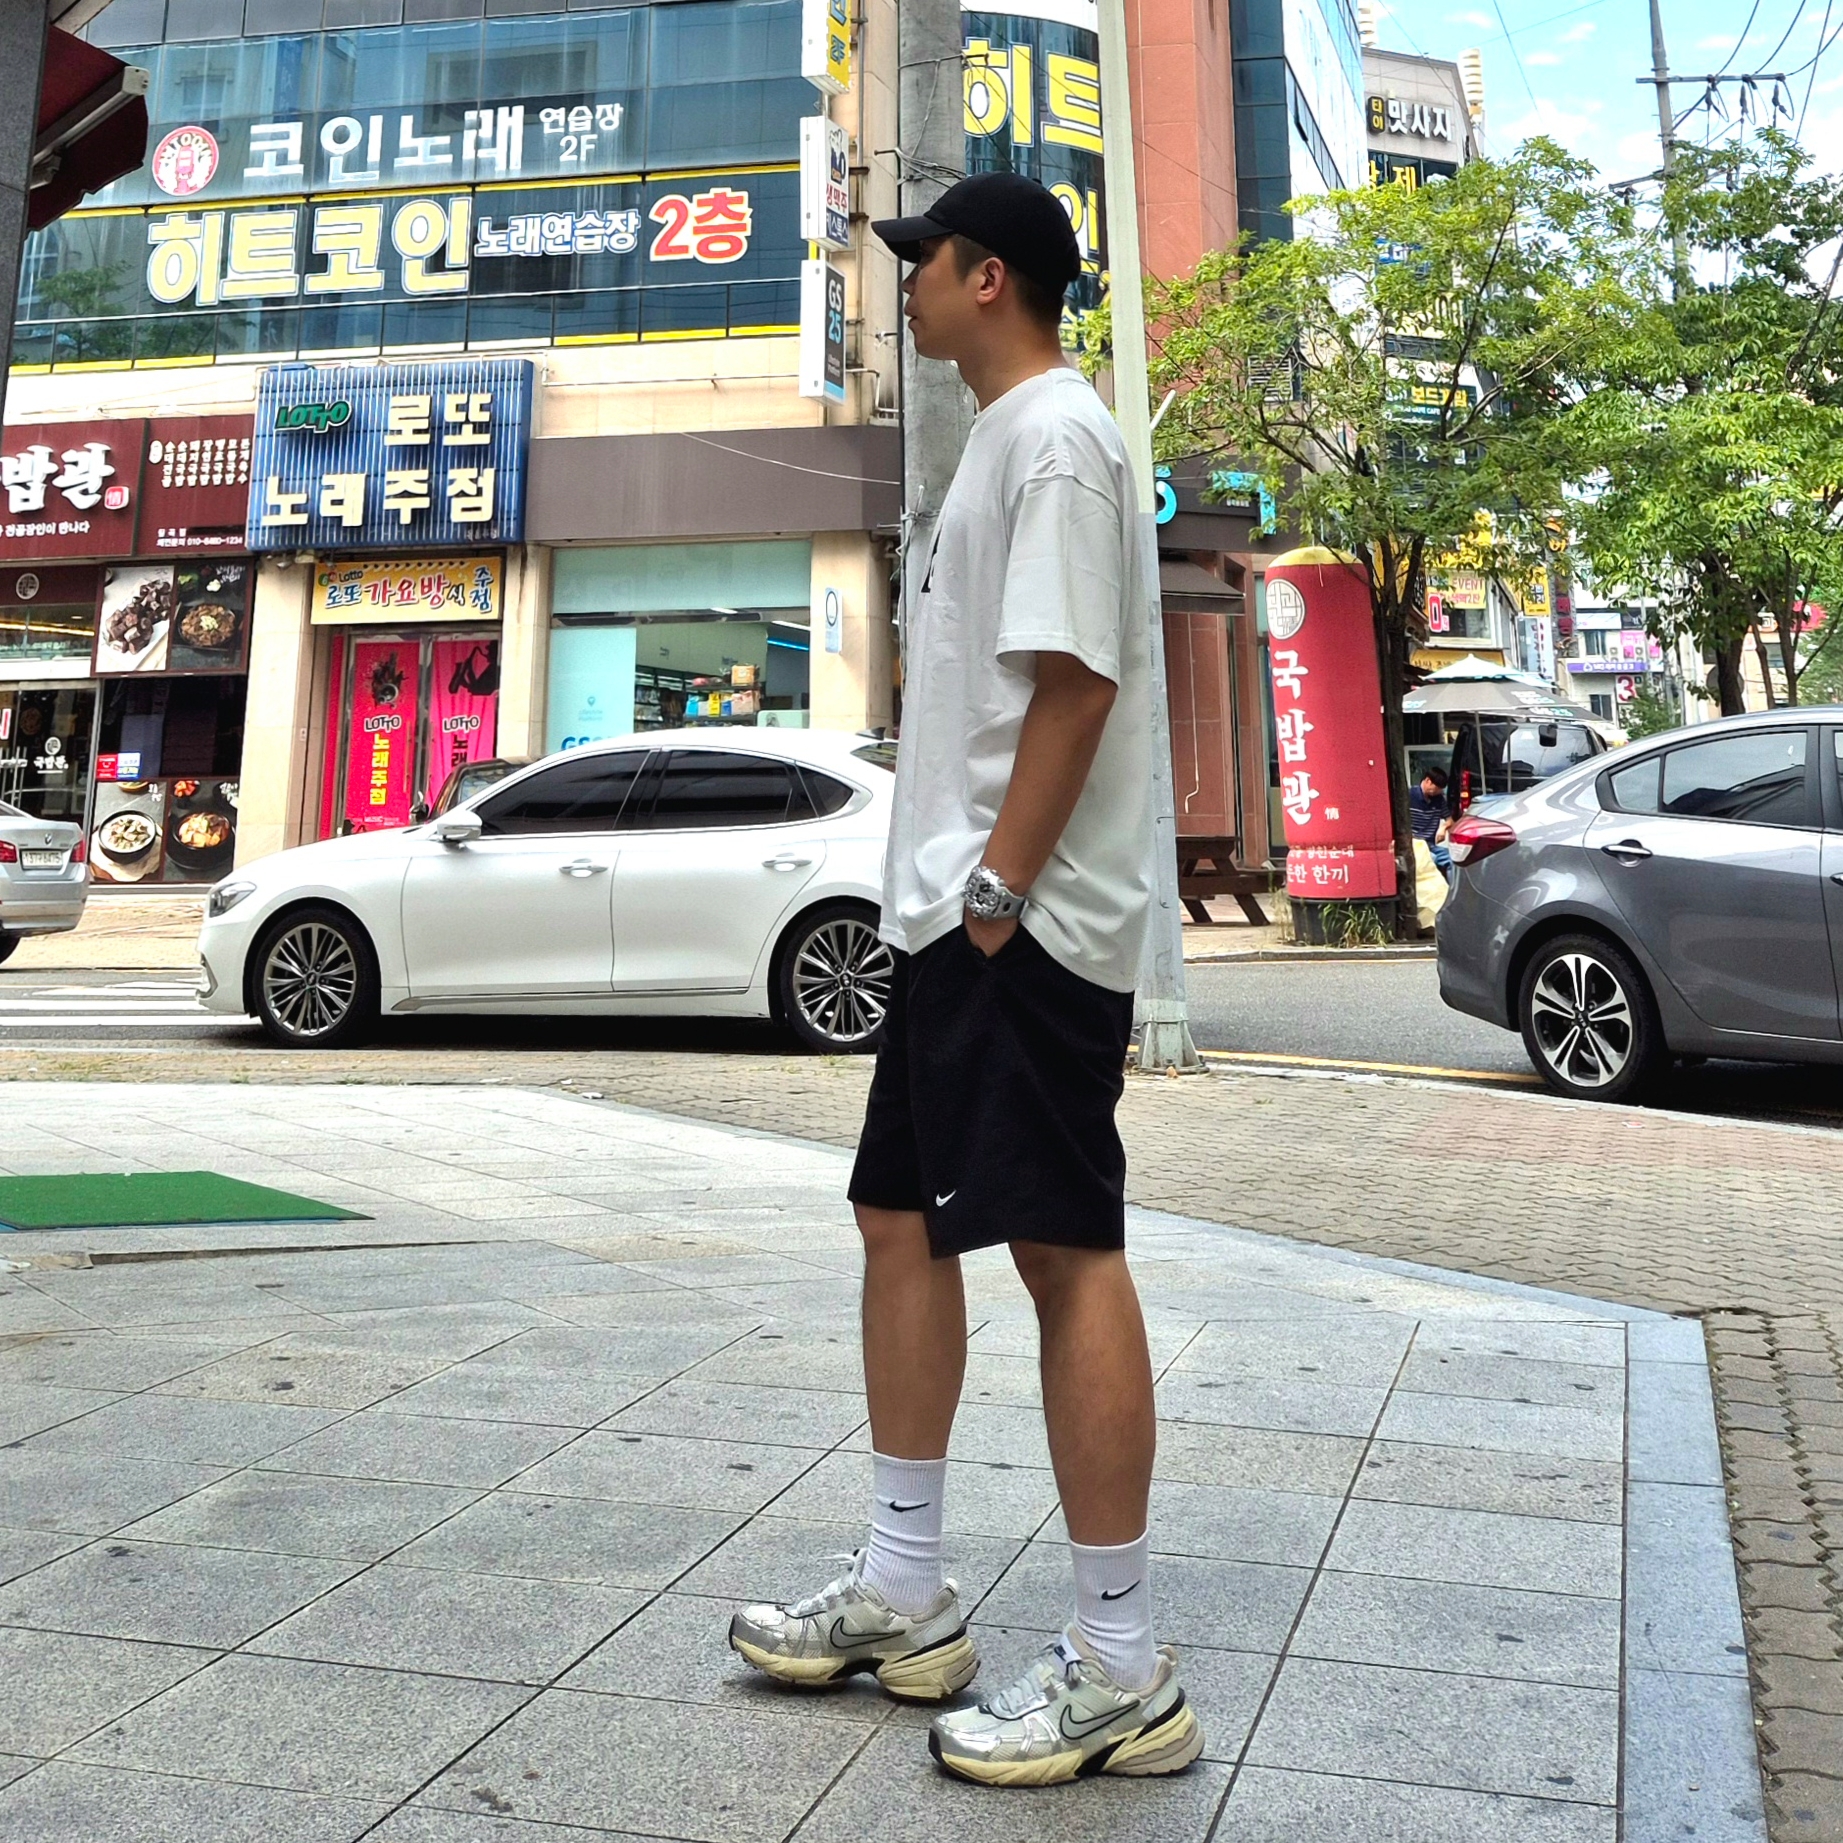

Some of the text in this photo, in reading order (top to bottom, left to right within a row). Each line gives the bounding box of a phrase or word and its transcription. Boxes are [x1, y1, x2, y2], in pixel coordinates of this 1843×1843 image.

[961, 36, 1104, 155] 히트
[1387, 99, 1452, 141] 맛사지
[243, 102, 625, 183] 코인노래 연습장
[558, 133, 599, 163] 2F
[147, 188, 752, 305] 히트코인 노래연습장 2층
[829, 279, 842, 312] GS
[829, 309, 842, 344] 25
[275, 400, 352, 434] LOTTO
[383, 393, 493, 446] 로또
[261, 467, 496, 527] 노래주점
[325, 583, 363, 609] 로또
[470, 566, 494, 613] 주점
[339, 569, 364, 583] Lotto
[364, 715, 402, 733] LOTTO
[442, 715, 480, 733] LOTTO
[1272, 650, 1321, 825] 국밥관
[369, 733, 391, 805] 노래주점
[1311, 863, 1349, 885] 한끼
